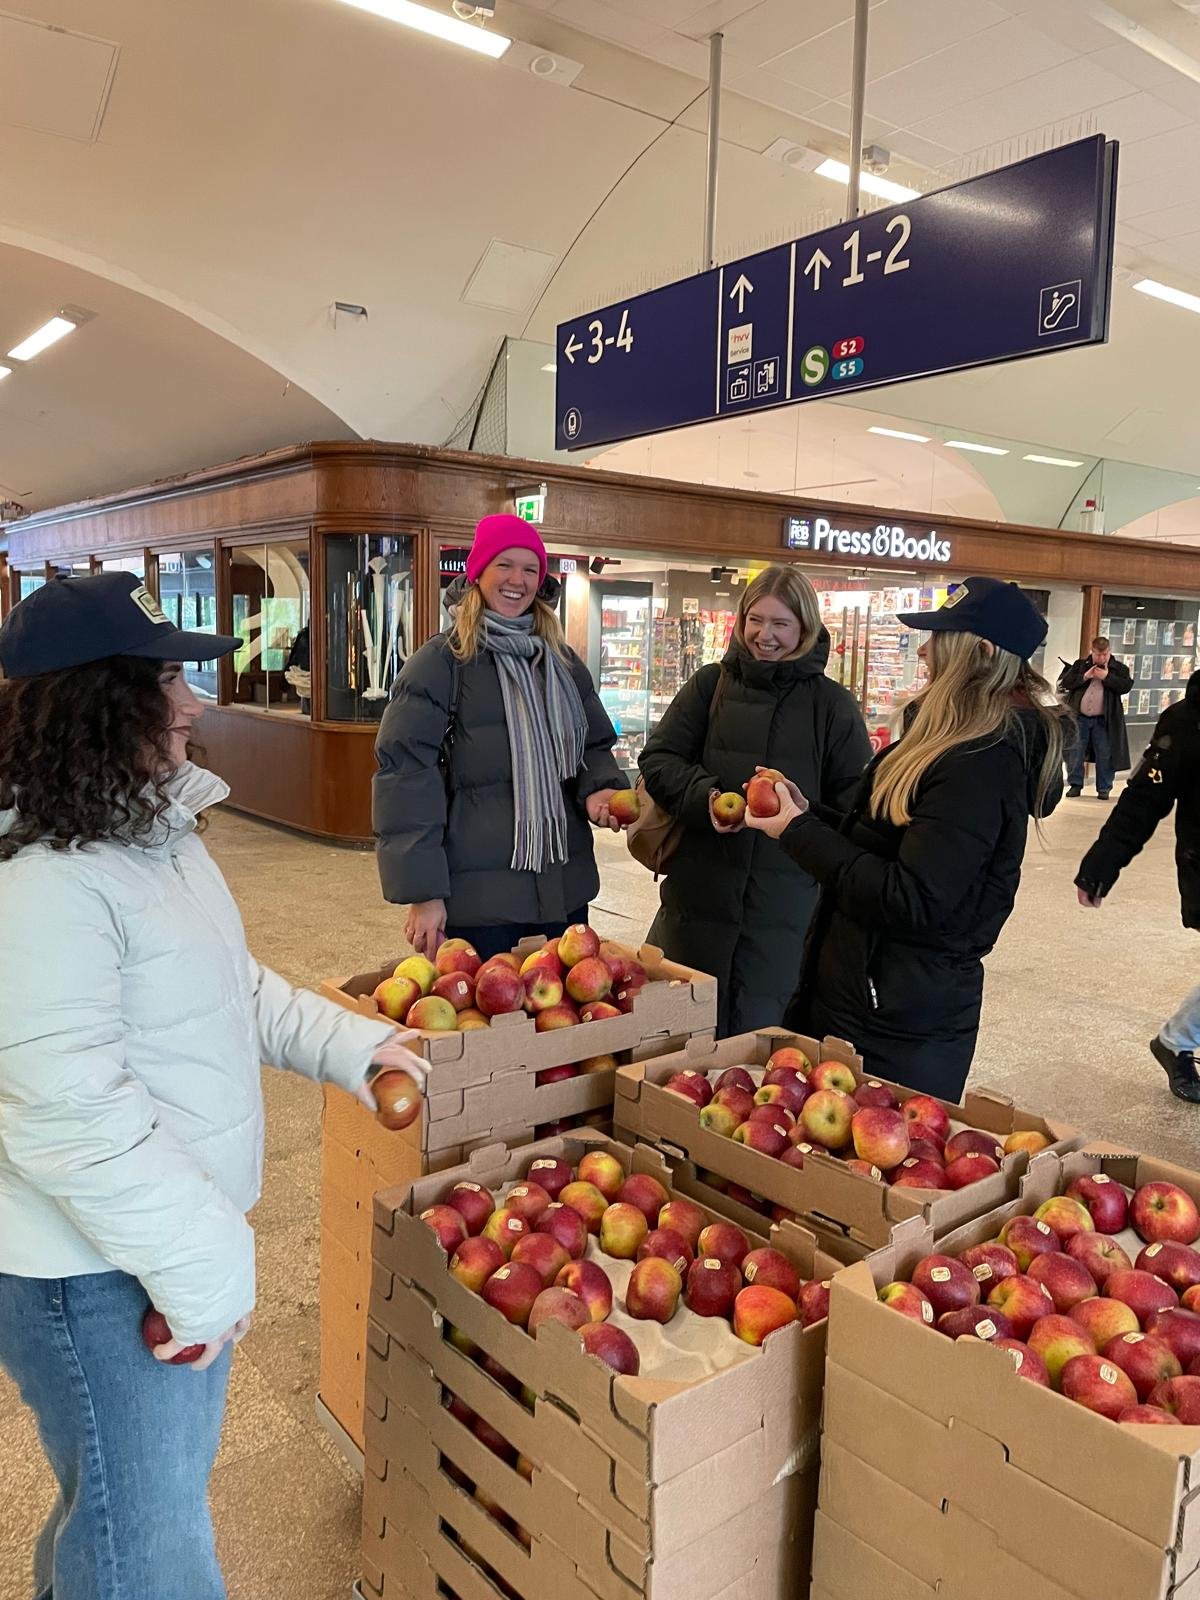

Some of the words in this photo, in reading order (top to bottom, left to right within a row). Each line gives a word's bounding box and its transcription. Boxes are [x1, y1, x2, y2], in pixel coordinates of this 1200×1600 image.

[842, 214, 912, 287] 1-2
[587, 309, 634, 365] 3-4
[733, 332, 750, 344] hvv
[840, 339, 857, 356] S2
[804, 348, 825, 384] S
[839, 360, 856, 377] S5
